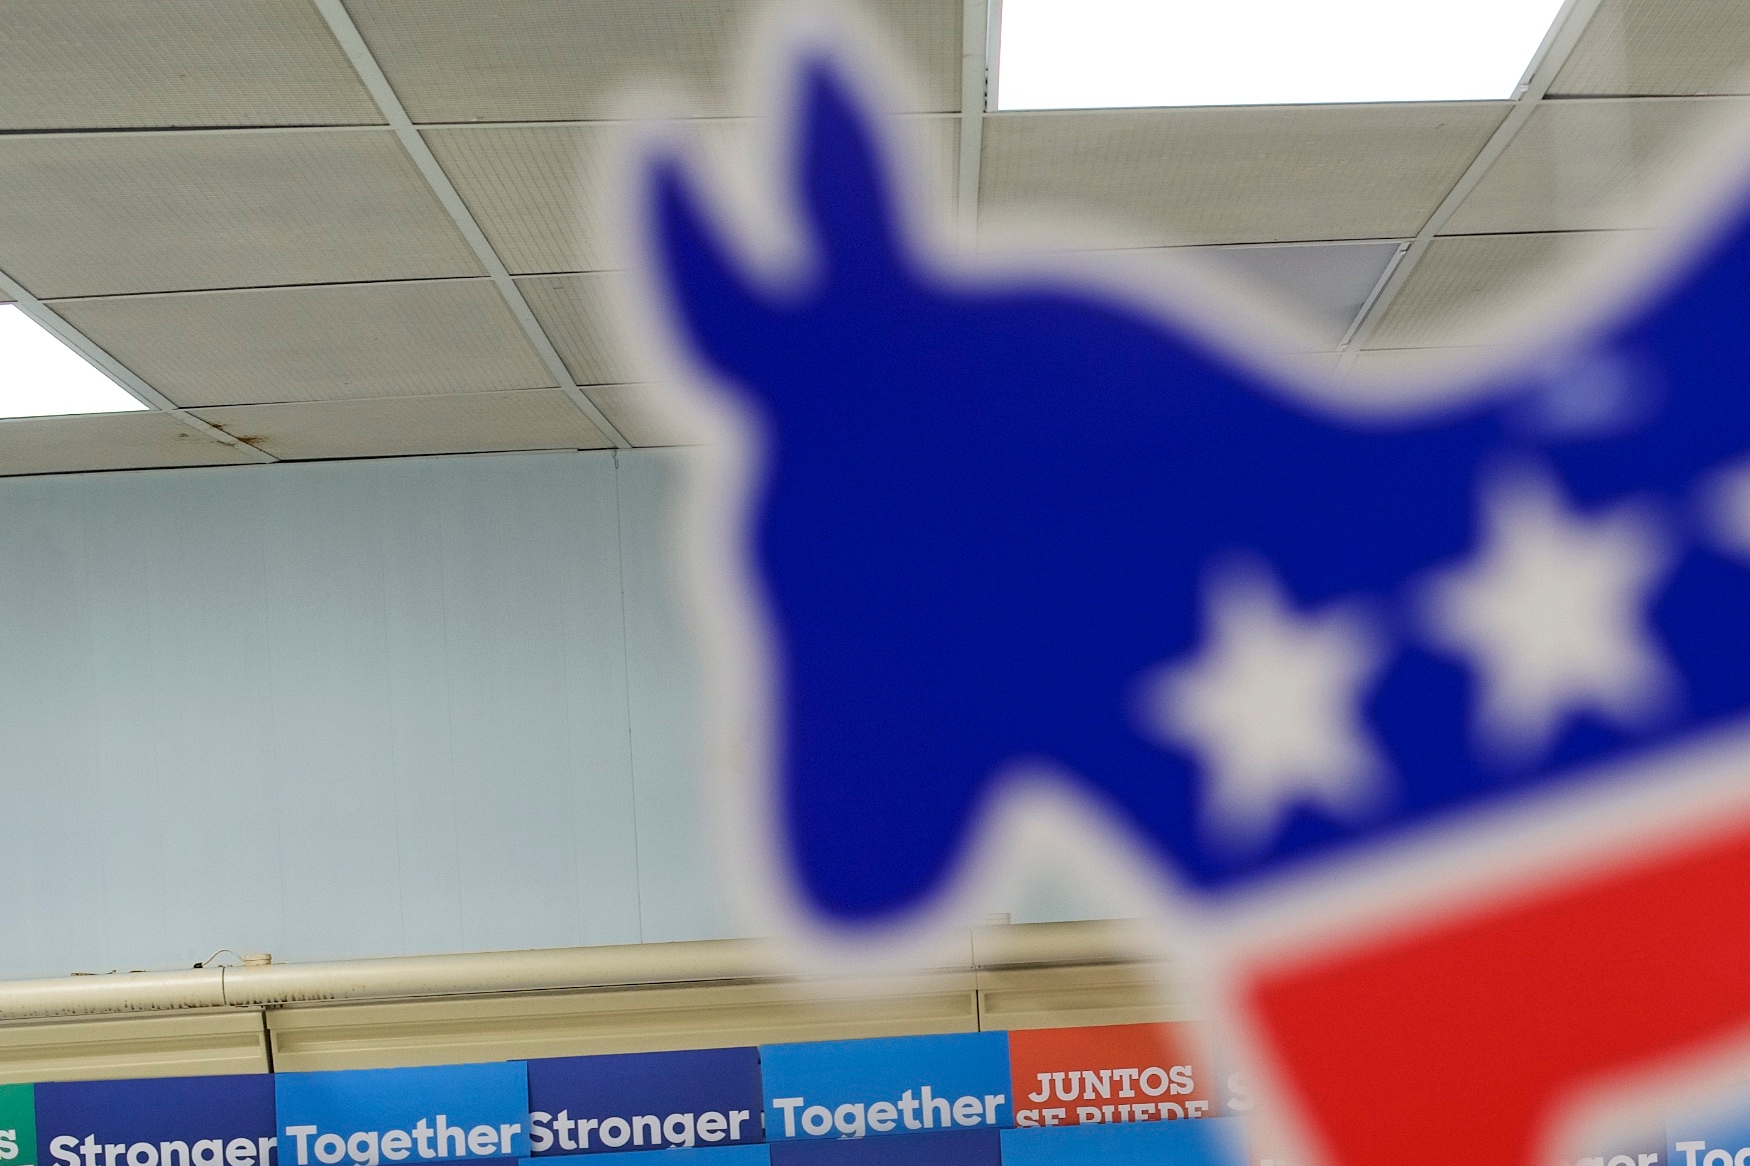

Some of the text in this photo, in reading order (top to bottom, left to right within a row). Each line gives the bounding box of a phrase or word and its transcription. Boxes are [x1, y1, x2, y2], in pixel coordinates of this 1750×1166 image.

[1028, 1065, 1194, 1102] JUNTOS
[531, 1110, 749, 1151] Stronger
[773, 1086, 1005, 1137] Together
[286, 1115, 521, 1166] Together
